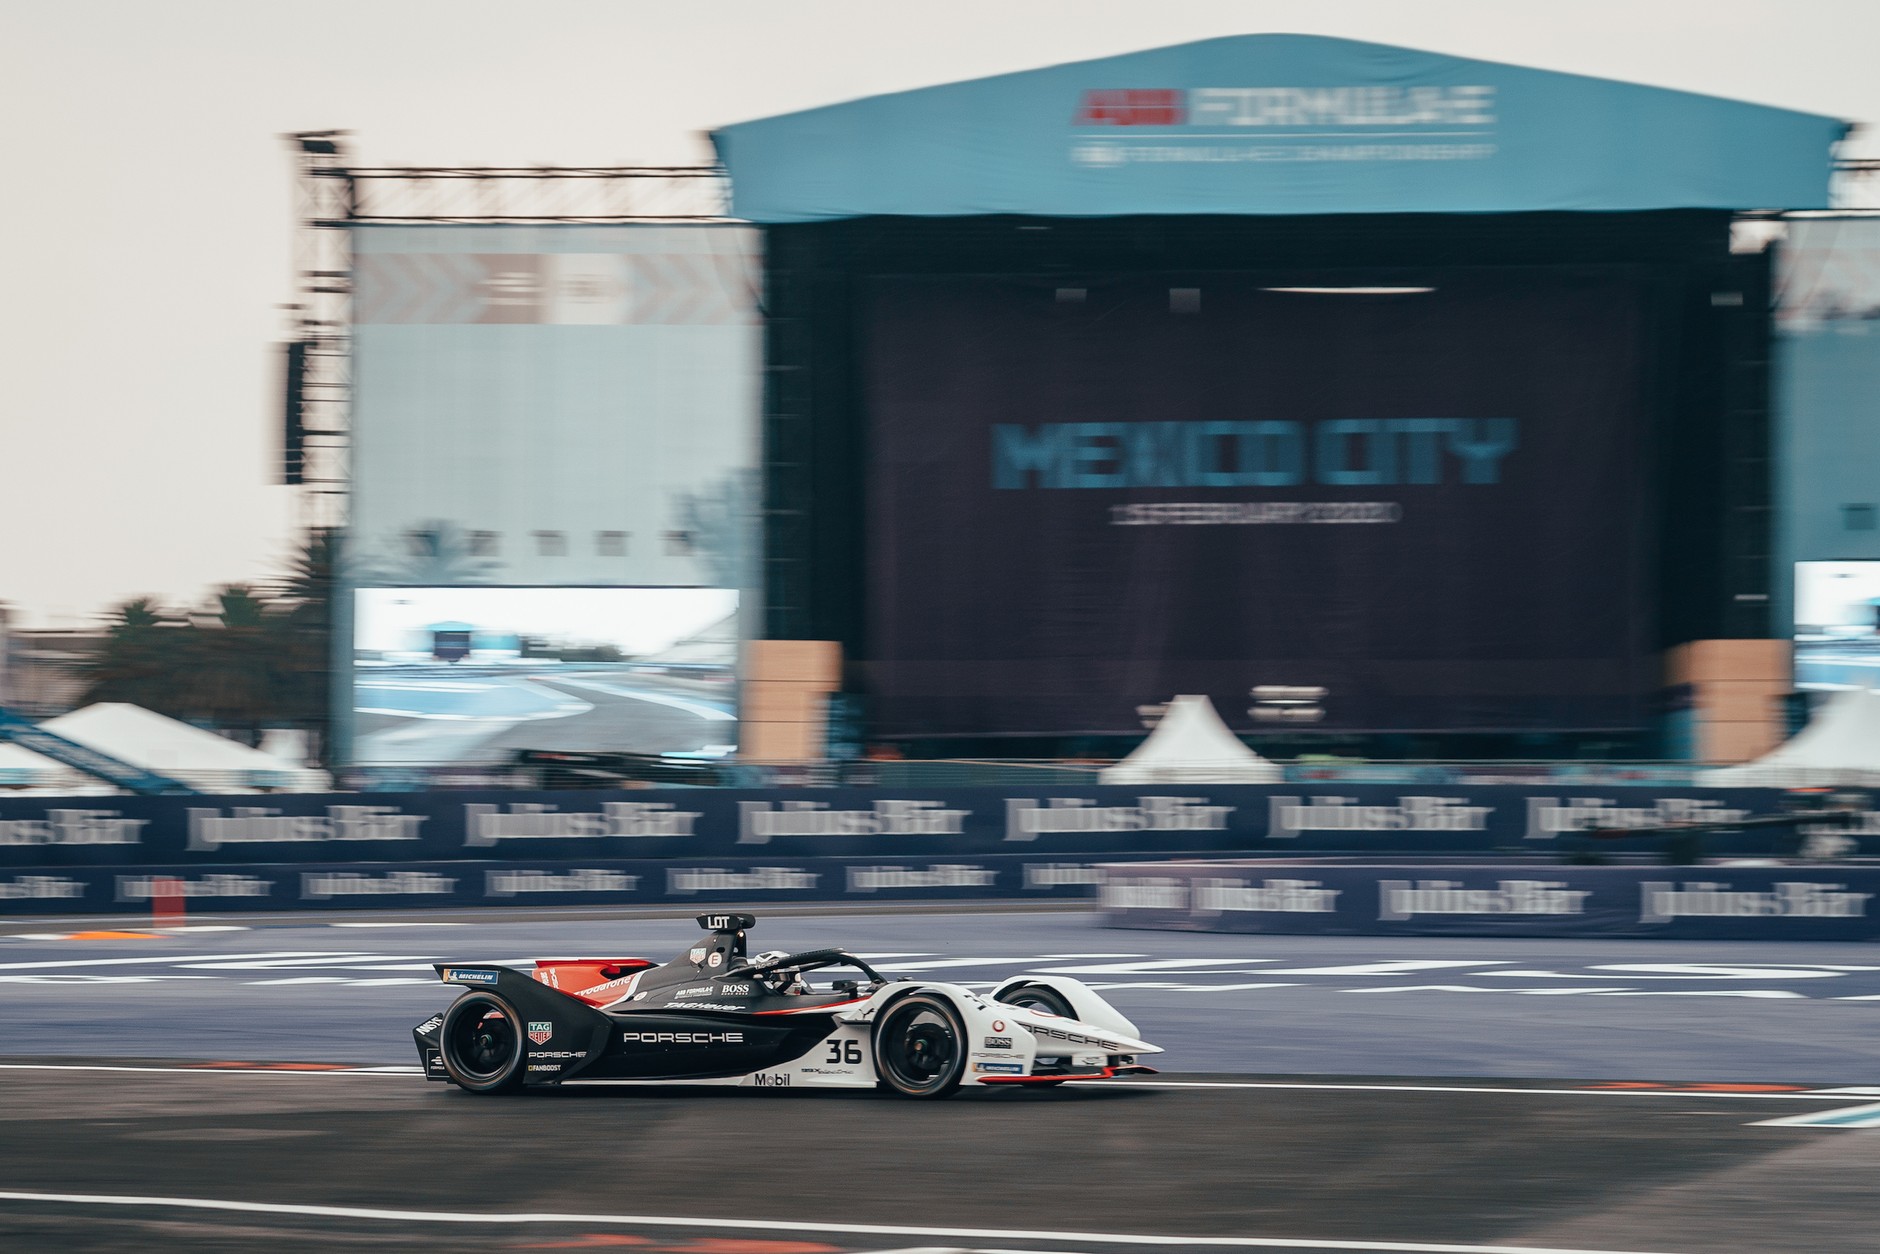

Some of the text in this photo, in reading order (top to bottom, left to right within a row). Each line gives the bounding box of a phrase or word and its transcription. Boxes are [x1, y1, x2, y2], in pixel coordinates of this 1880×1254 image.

[990, 418, 1519, 489] MEXICO CITY
[708, 916, 730, 929] LOT
[722, 984, 750, 993] BOSS
[531, 1023, 550, 1031] TAG
[530, 1031, 551, 1043] HEUER
[623, 1032, 744, 1043] PORSCHE
[1019, 1023, 1119, 1051] ORSCHE
[826, 1039, 863, 1065] 36
[754, 1073, 790, 1087] Mobil
